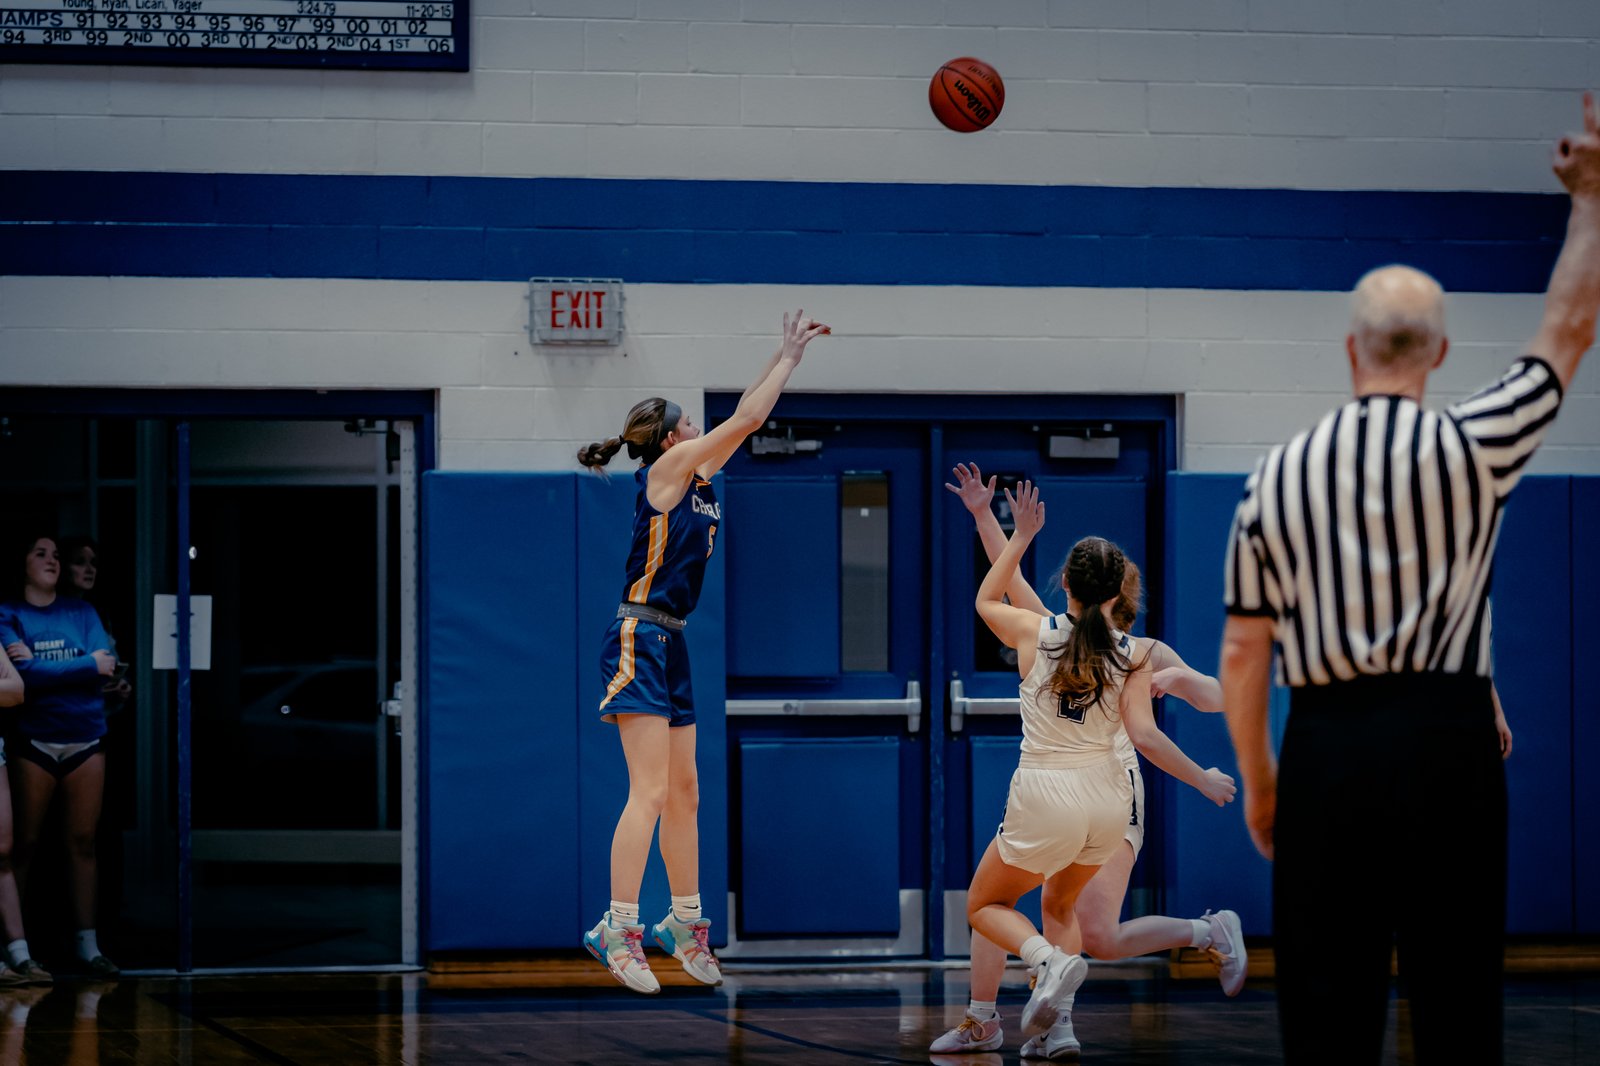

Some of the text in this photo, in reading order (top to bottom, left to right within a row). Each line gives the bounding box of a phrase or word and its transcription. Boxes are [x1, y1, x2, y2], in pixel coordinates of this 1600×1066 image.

[407, 5, 451, 18] 11-20-15
[73, 12, 95, 28] '91
[103, 13, 128, 29] '92
[137, 14, 162, 30] '93
[171, 15, 196, 30] '94
[205, 16, 230, 31] '95
[239, 16, 265, 32] '96
[309, 18, 335, 33] '99
[343, 19, 370, 34] '00
[377, 19, 398, 35] '01
[405, 20, 427, 35] '02
[43, 30, 72, 45] 3RD
[82, 30, 108, 46] '99
[123, 31, 153, 47] 2ND
[163, 32, 190, 48] '00
[201, 32, 230, 48] 3RD
[327, 36, 355, 51] 2ND
[388, 38, 411, 52] 1ST
[424, 39, 450, 53] '06
[954, 80, 991, 121] Wilson
[551, 290, 607, 329] EXIT
[34, 639, 65, 651] ROSARY
